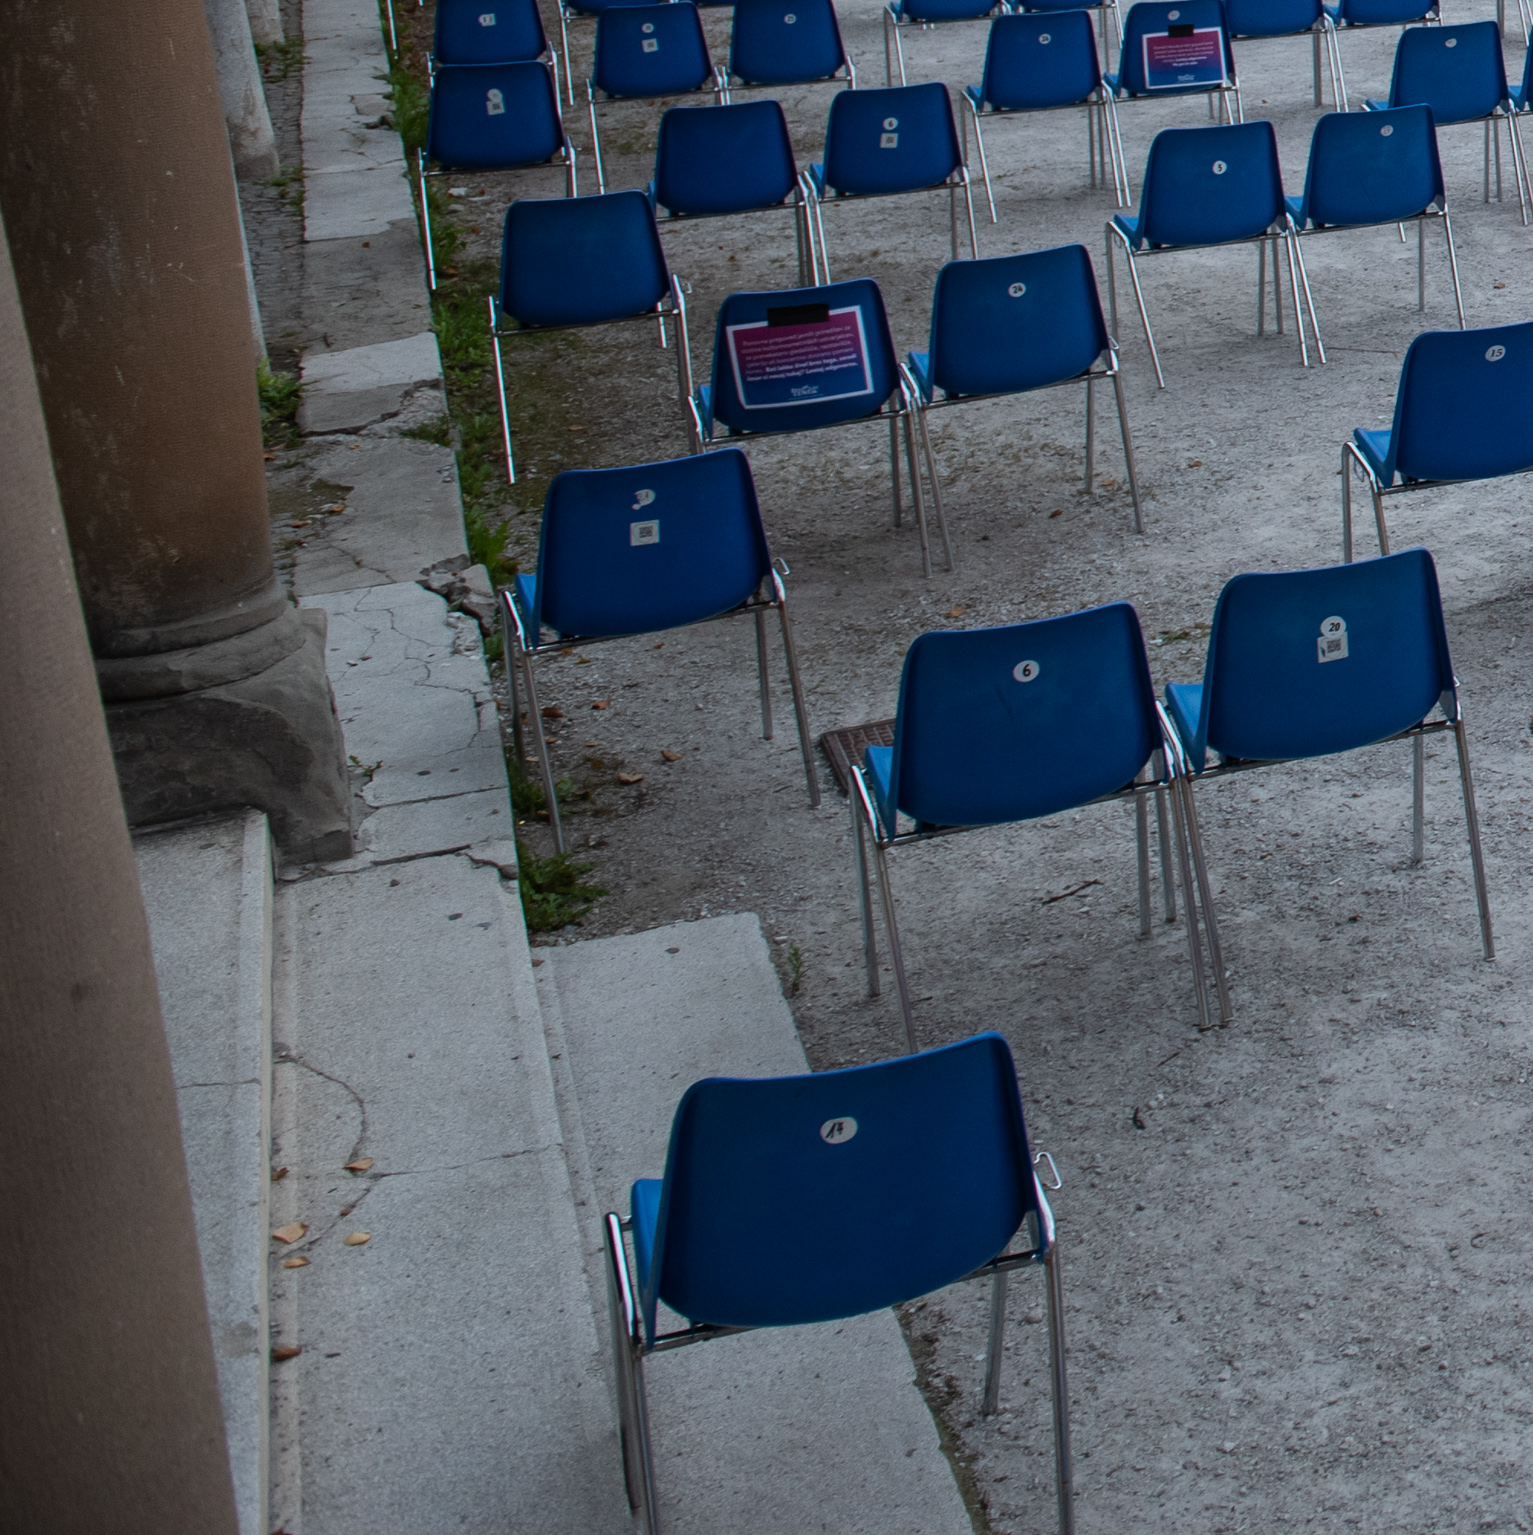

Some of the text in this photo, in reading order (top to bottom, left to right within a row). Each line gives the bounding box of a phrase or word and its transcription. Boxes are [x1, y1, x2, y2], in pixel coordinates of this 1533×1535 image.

[1012, 285, 1022, 294] 24
[768, 335, 797, 345] prepoved
[1490, 349, 1502, 357] 15
[1329, 623, 1340, 632] 20
[1022, 664, 1031, 676] 6
